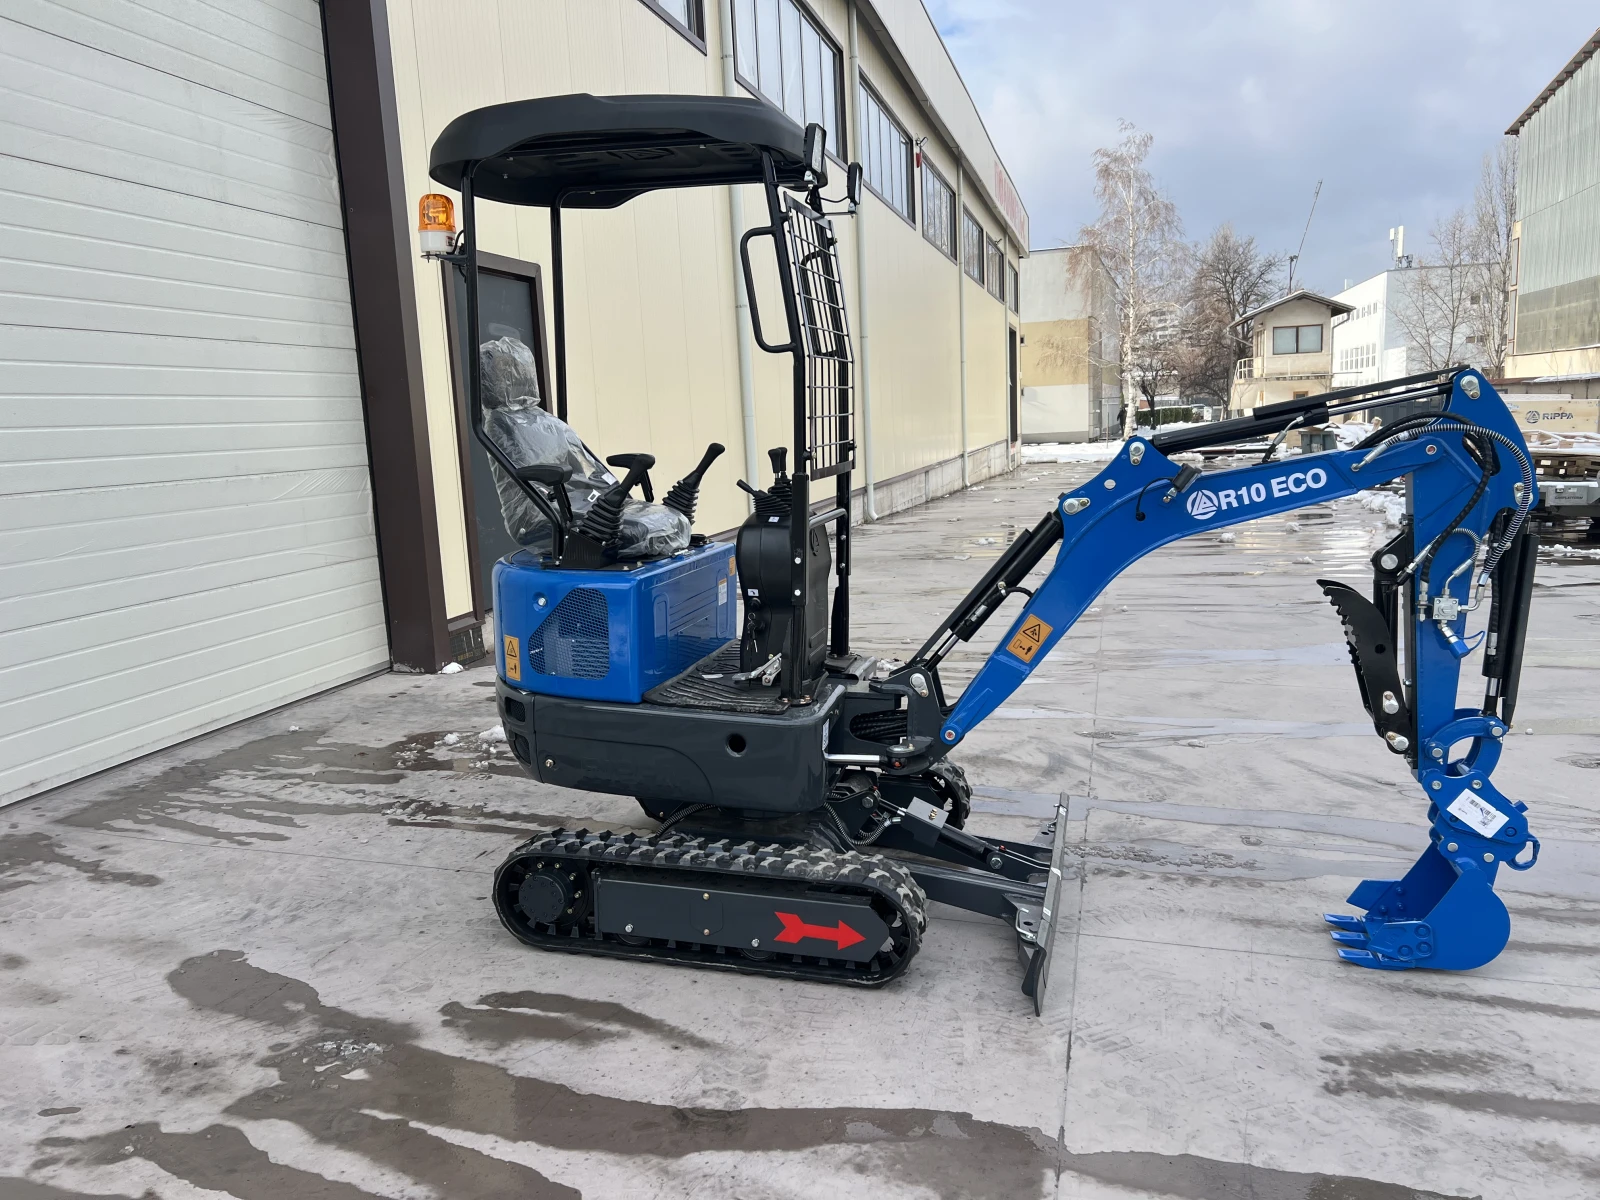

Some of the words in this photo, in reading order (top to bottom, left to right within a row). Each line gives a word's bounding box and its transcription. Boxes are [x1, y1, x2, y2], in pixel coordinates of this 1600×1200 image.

[1542, 412, 1574, 420] RIPPA
[1218, 483, 1267, 510] R10
[1270, 468, 1327, 498] ECO
